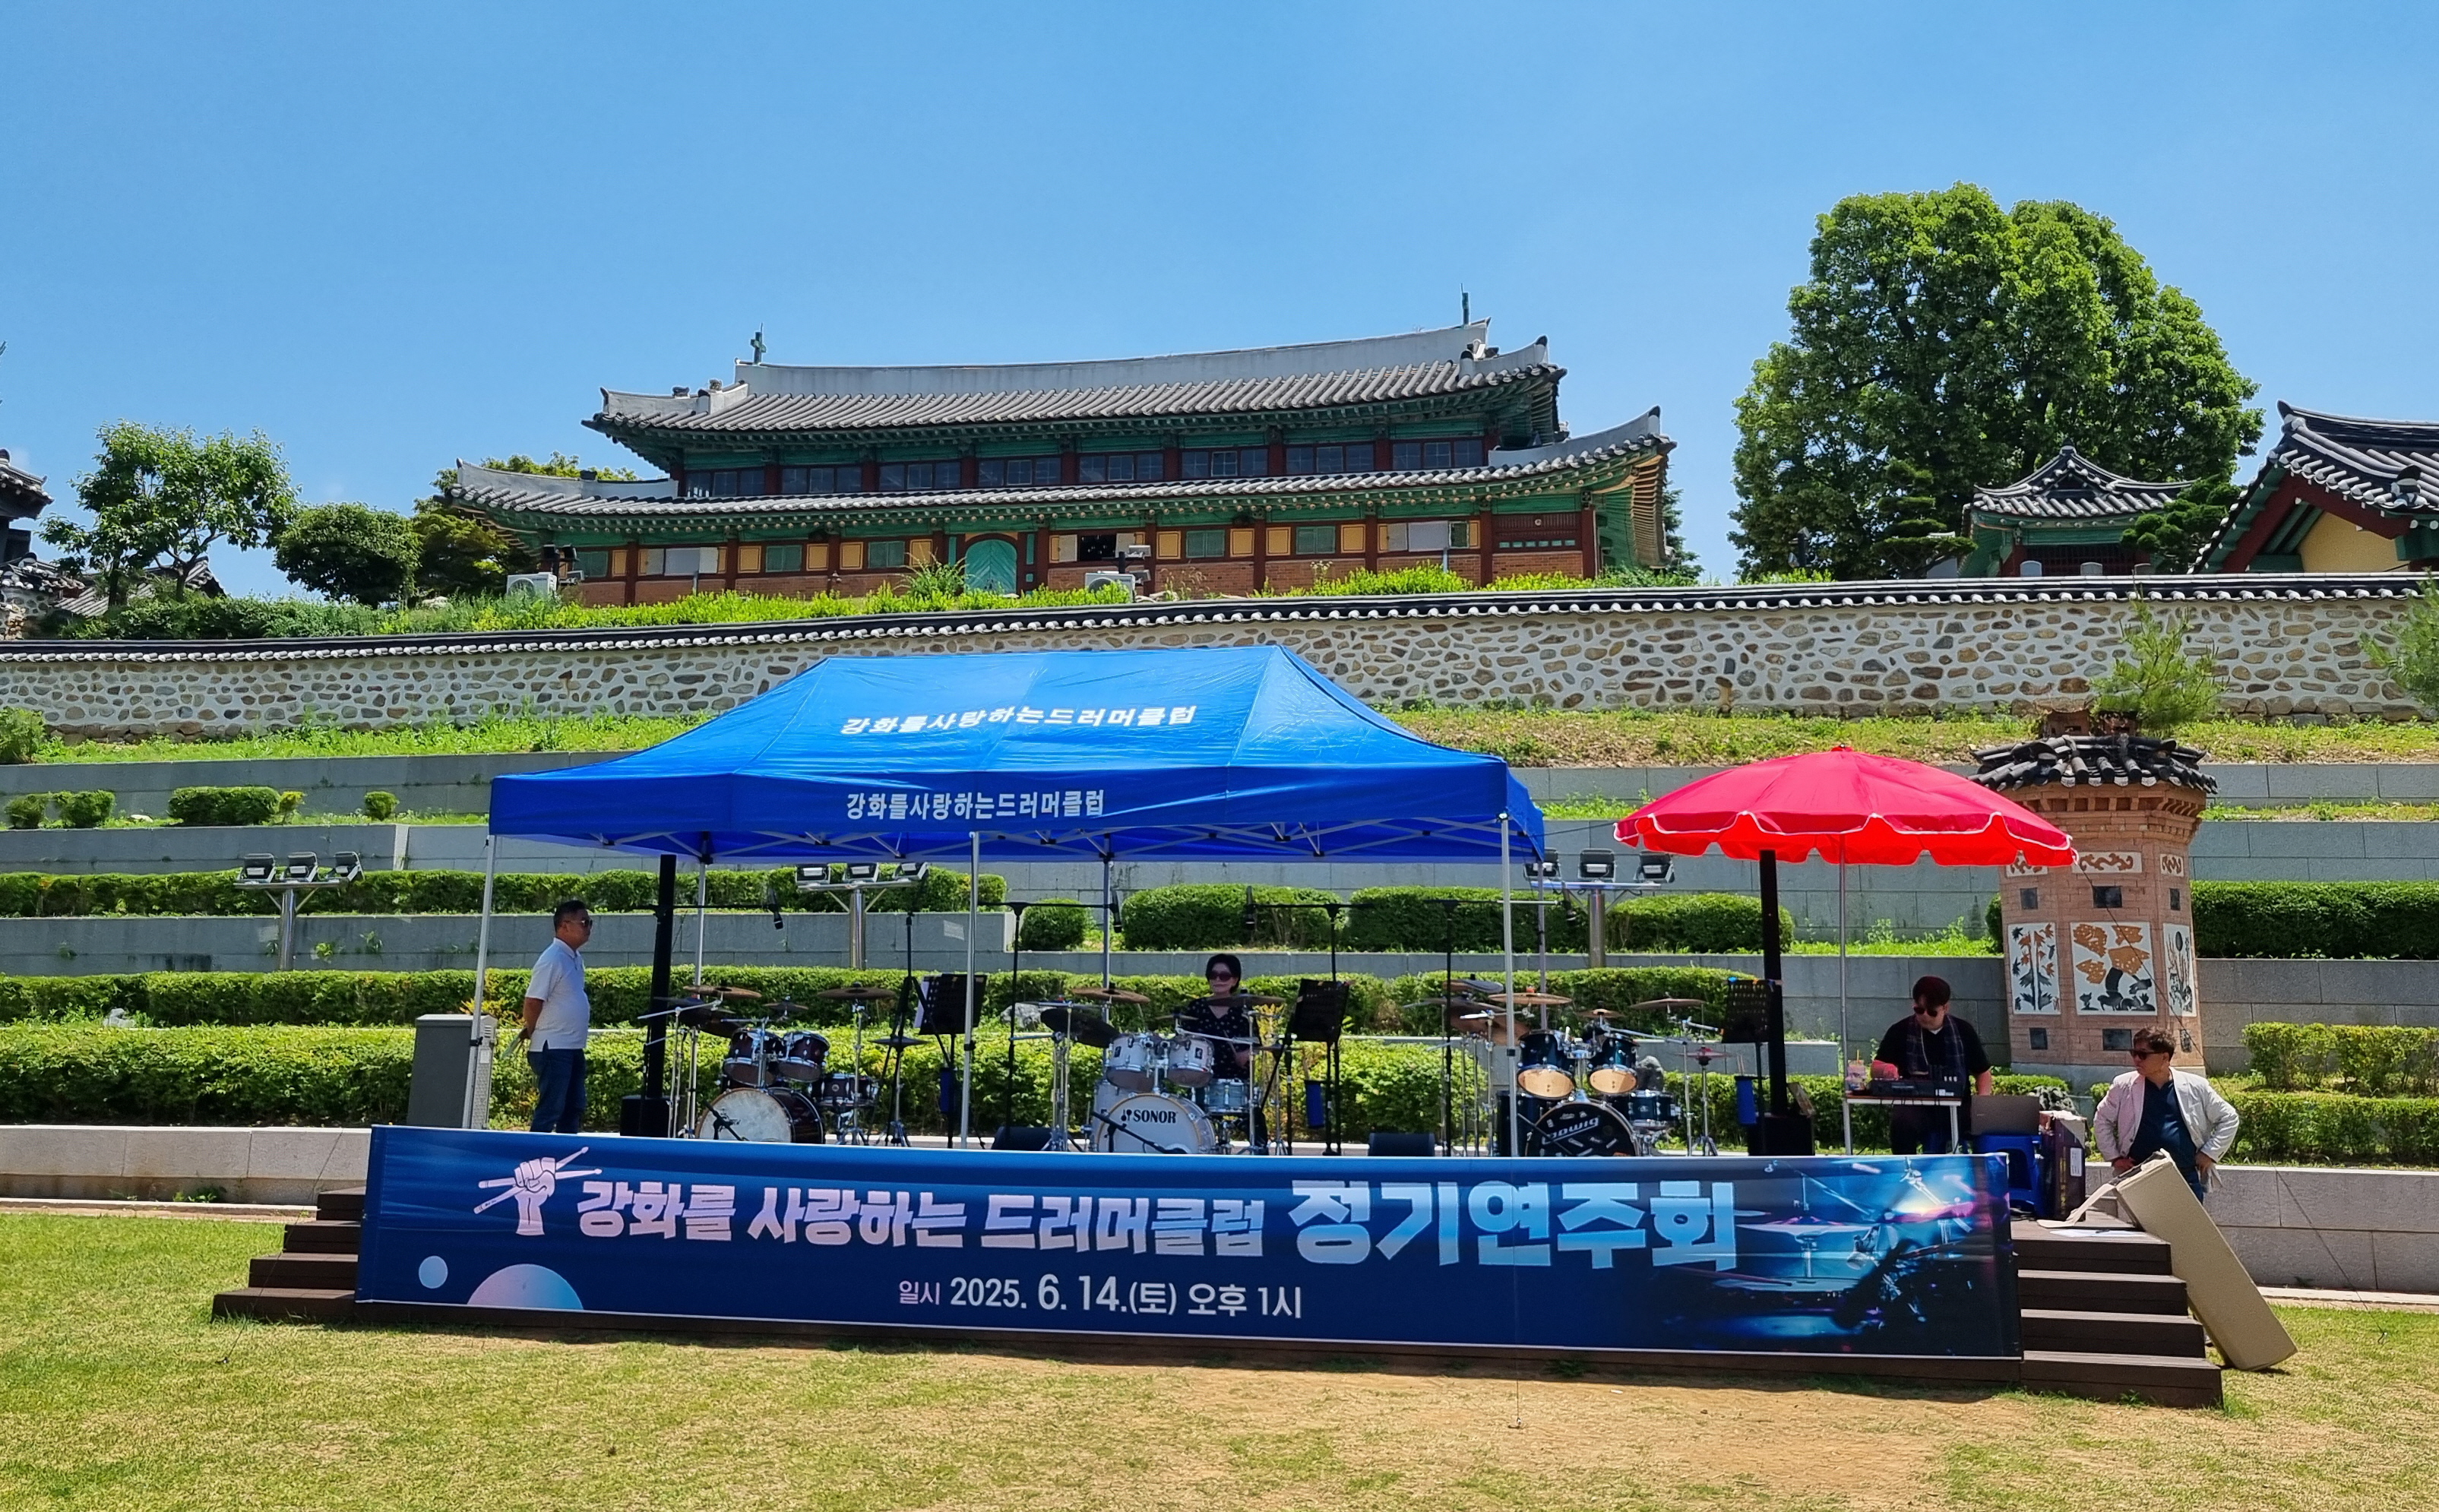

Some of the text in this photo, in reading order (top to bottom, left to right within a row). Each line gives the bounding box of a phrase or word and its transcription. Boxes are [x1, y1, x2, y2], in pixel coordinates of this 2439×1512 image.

[840, 705, 1197, 735] 강화를사랑하는드러머클럽
[846, 789, 1105, 821] 강화를사랑하는드러머클럽
[1133, 1109, 1177, 1124] SONOR
[577, 1180, 1737, 1272] 강화를 사랑하는 드러머클럽 정기연주회
[898, 1273, 1302, 1320] 일시 2025. 6. 14.(토) 오후 1시
